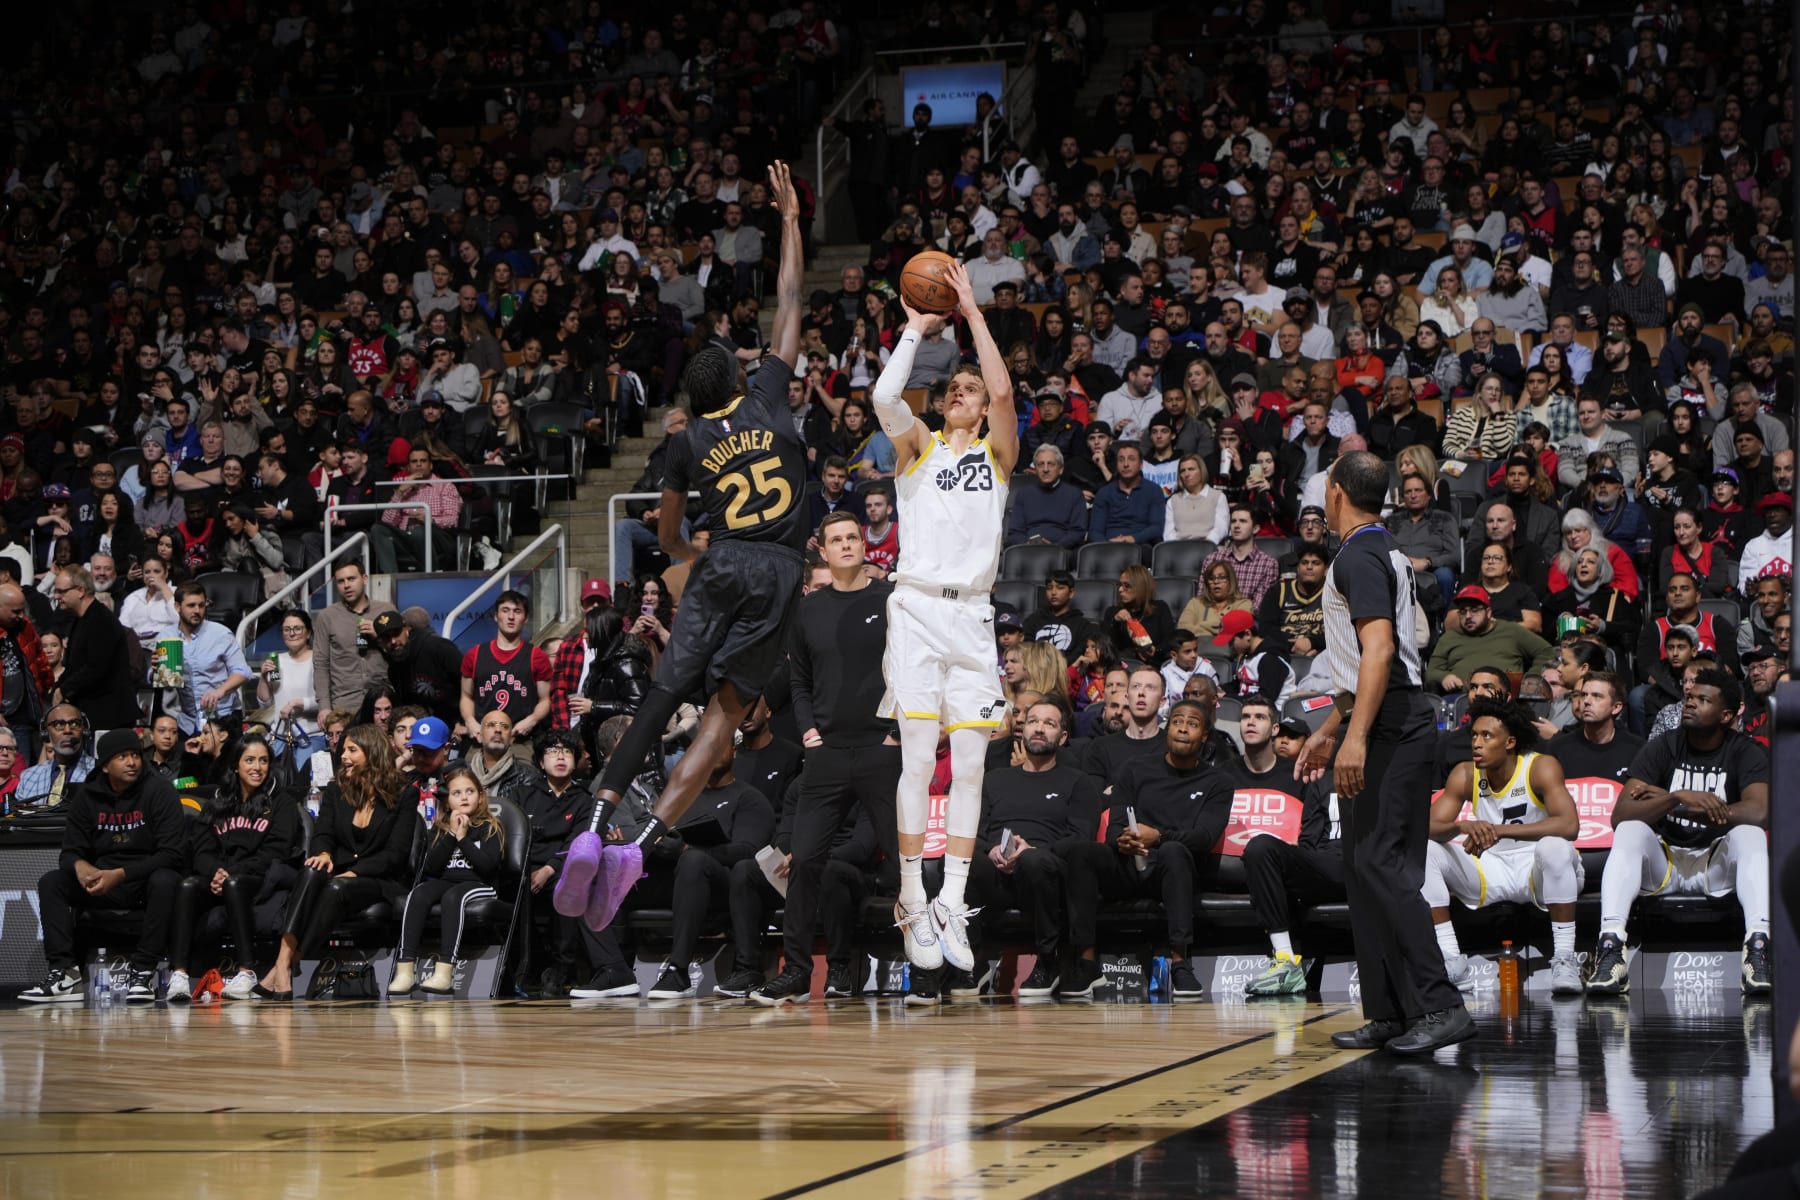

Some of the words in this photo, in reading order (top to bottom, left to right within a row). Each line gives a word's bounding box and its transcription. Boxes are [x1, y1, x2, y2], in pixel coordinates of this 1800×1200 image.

[701, 429, 774, 473] BOUCHER
[963, 464, 993, 491] 23
[715, 456, 792, 531] 25
[942, 587, 959, 600] UTAH
[479, 671, 527, 697] RAPTORS
[495, 689, 510, 711] 9
[1229, 815, 1284, 825] STEEL
[1101, 963, 1142, 974] SPALDING
[1221, 956, 1268, 973] Dove
[1673, 952, 1723, 969] Dove
[1221, 973, 1253, 985] MEN
[1673, 970, 1707, 980] MEN
